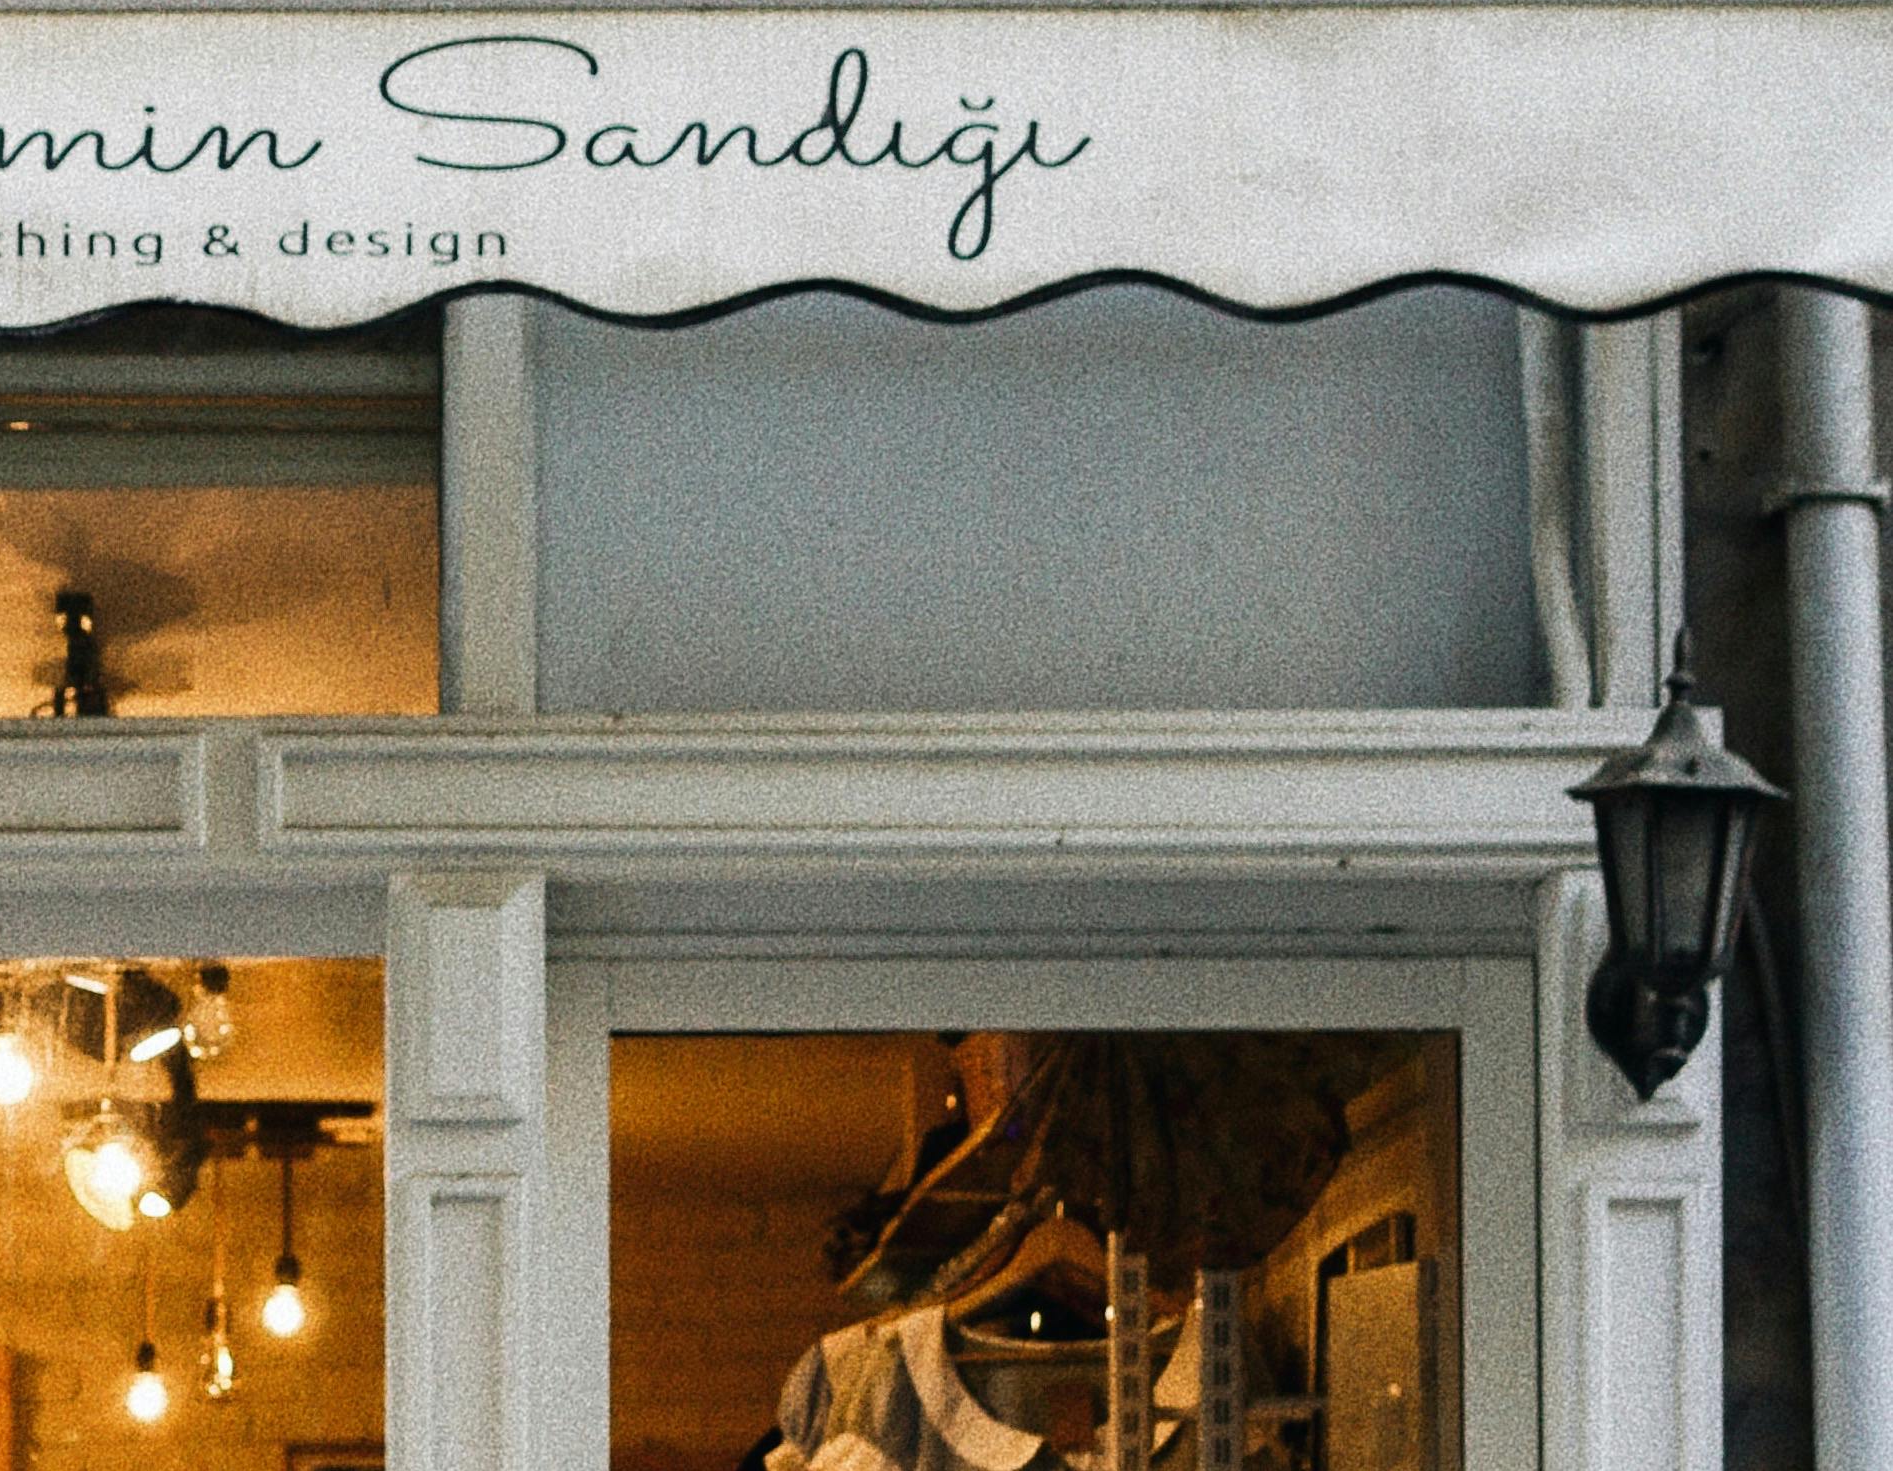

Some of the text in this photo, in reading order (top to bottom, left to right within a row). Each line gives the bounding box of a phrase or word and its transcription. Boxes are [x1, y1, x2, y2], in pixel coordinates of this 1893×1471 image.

[377, 34, 1092, 261] Sandığı
[200, 222, 243, 259] &
[275, 218, 508, 266] design
